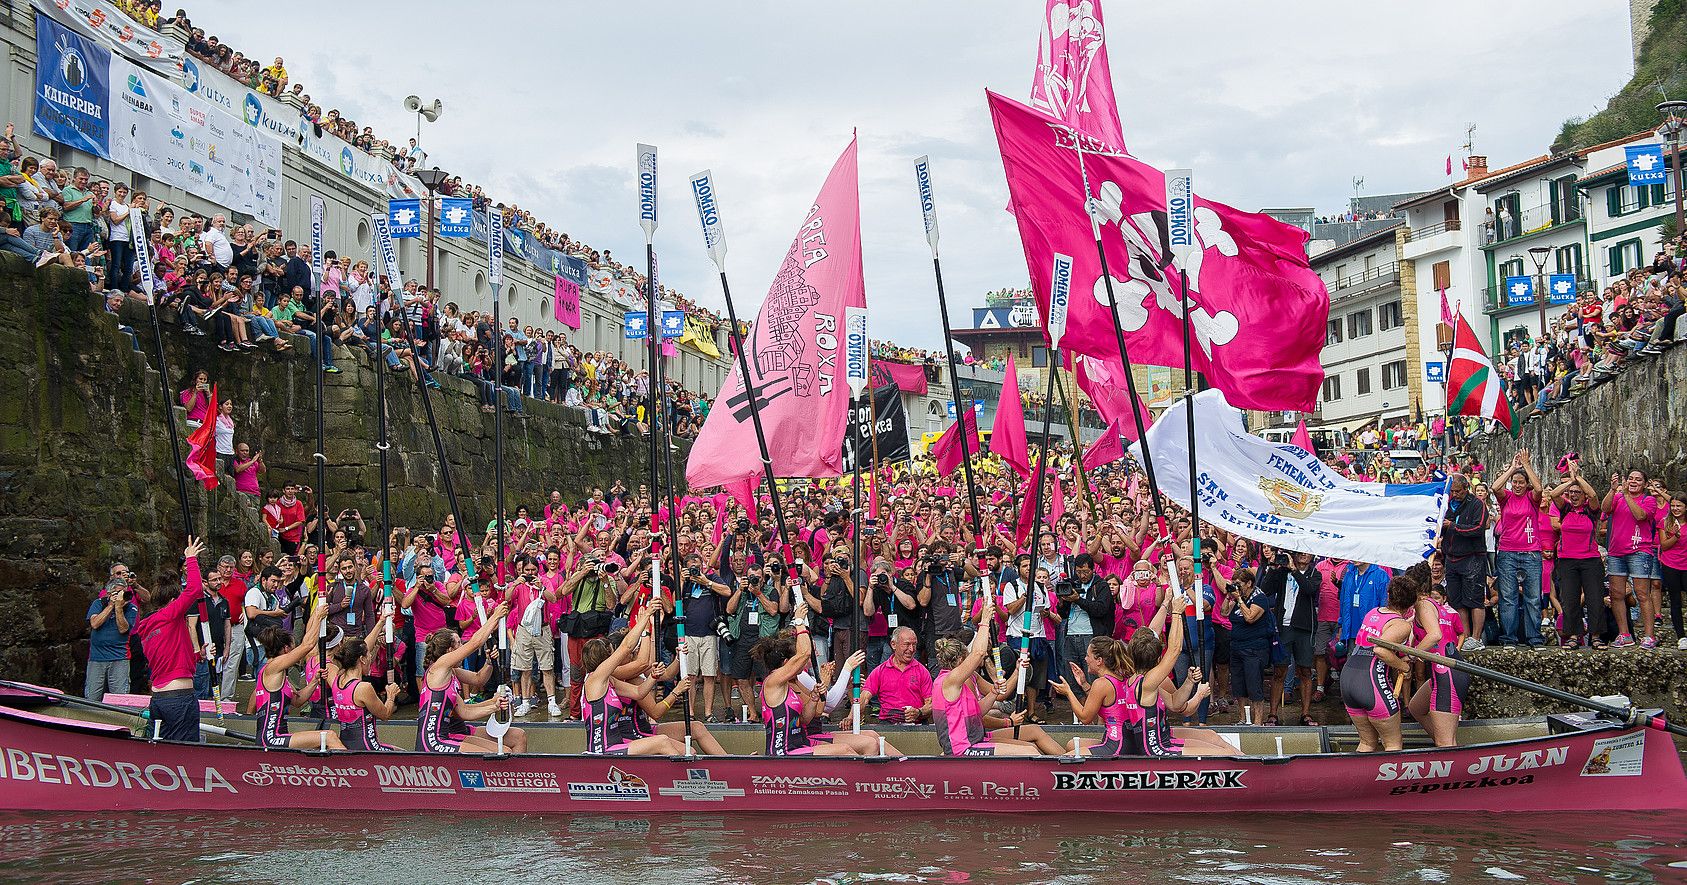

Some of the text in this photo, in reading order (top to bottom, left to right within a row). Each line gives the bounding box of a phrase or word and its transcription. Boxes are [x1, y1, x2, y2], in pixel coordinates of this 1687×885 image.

[44, 84, 102, 119] KAIARRIBA
[199, 78, 232, 109] kutxa
[261, 112, 296, 138] kutxa
[308, 136, 332, 162] kutxa
[354, 162, 384, 184] kutxa
[1630, 172, 1664, 181] kutxa
[391, 226, 419, 234] kutxa
[441, 224, 469, 233] kutxa
[560, 261, 581, 278] kutxa
[1551, 293, 1575, 301] kutxa
[813, 311, 838, 397] ROXA
[1307, 459, 1322, 477] DE
[1197, 472, 1229, 501] SAN
[427, 714, 437, 731] 1965
[1148, 729, 1158, 746] 1965
[0, 746, 239, 794] IBERDROLA
[258, 763, 369, 777] EuskoAuto
[1375, 746, 1570, 782] SAN JUAN
[276, 774, 352, 788] TOYOTA
[486, 778, 559, 787] NUTERGIA
[751, 775, 848, 786] ZAMAKONA
[943, 780, 1040, 797] La Perla
[1051, 770, 1248, 790] BATELERAK
[1389, 774, 1535, 796] gipuzkoa
